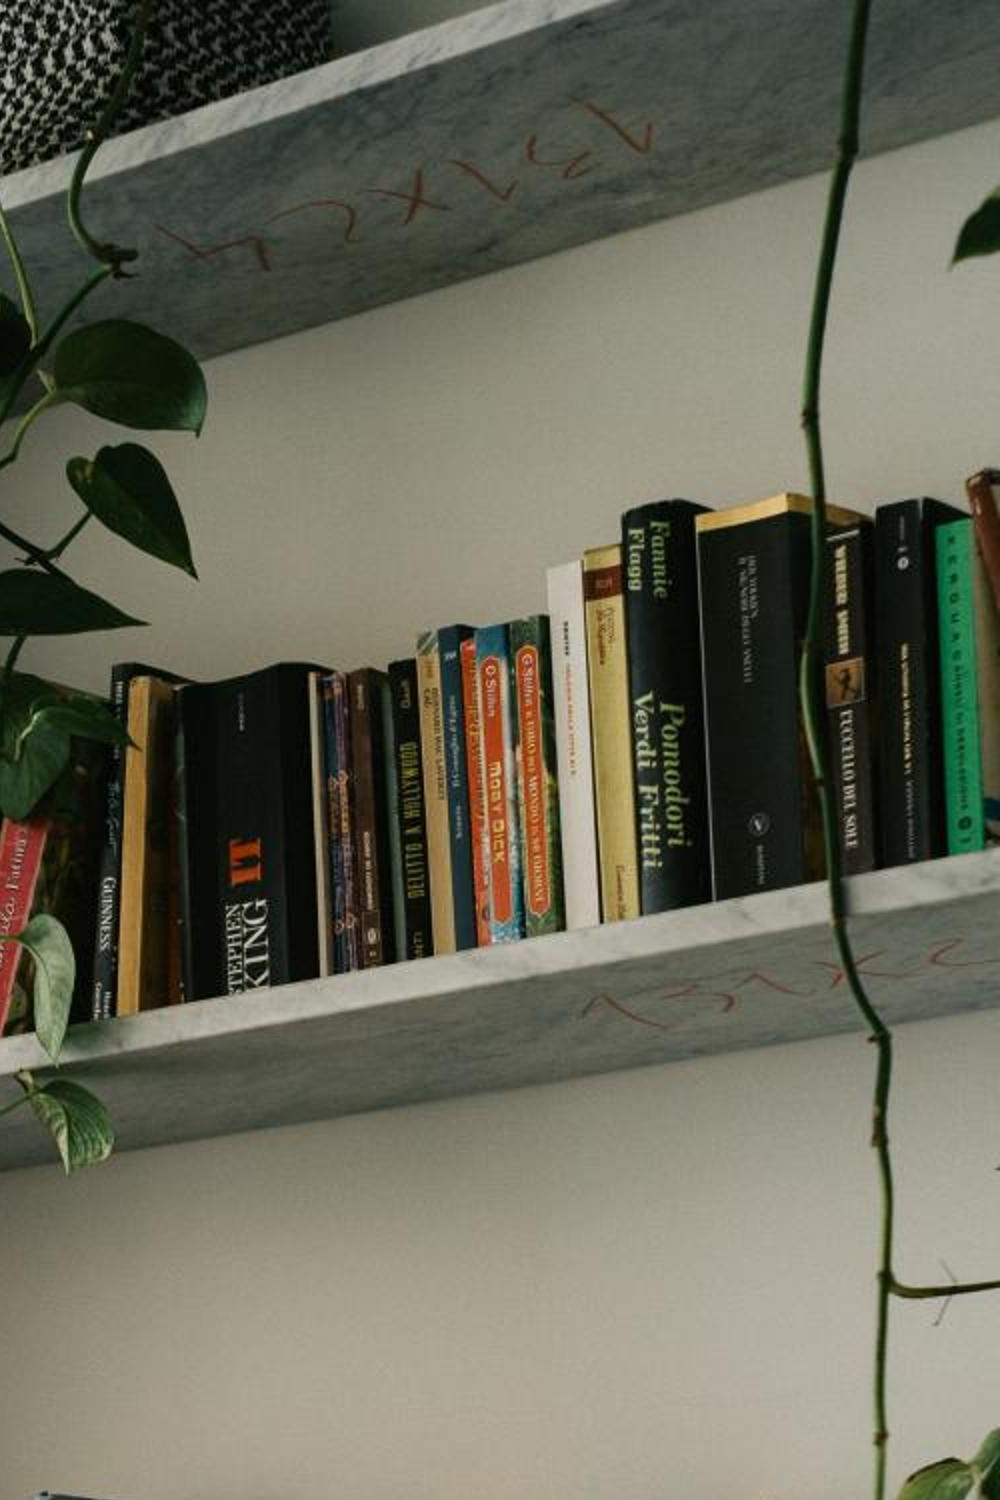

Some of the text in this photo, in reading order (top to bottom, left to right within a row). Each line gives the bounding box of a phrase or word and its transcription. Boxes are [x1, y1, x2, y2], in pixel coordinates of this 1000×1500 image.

[627, 527, 645, 592] Flagg
[648, 520, 667, 599] Fannie
[399, 741, 421, 820] HOLLYWOOD
[634, 691, 663, 869] Verdi Fritti
[658, 702, 693, 848] Pomodori
[229, 837, 262, 887] IT
[491, 818, 506, 864] DICK
[99, 876, 117, 953] GUINNESS
[241, 898, 270, 991] KING
